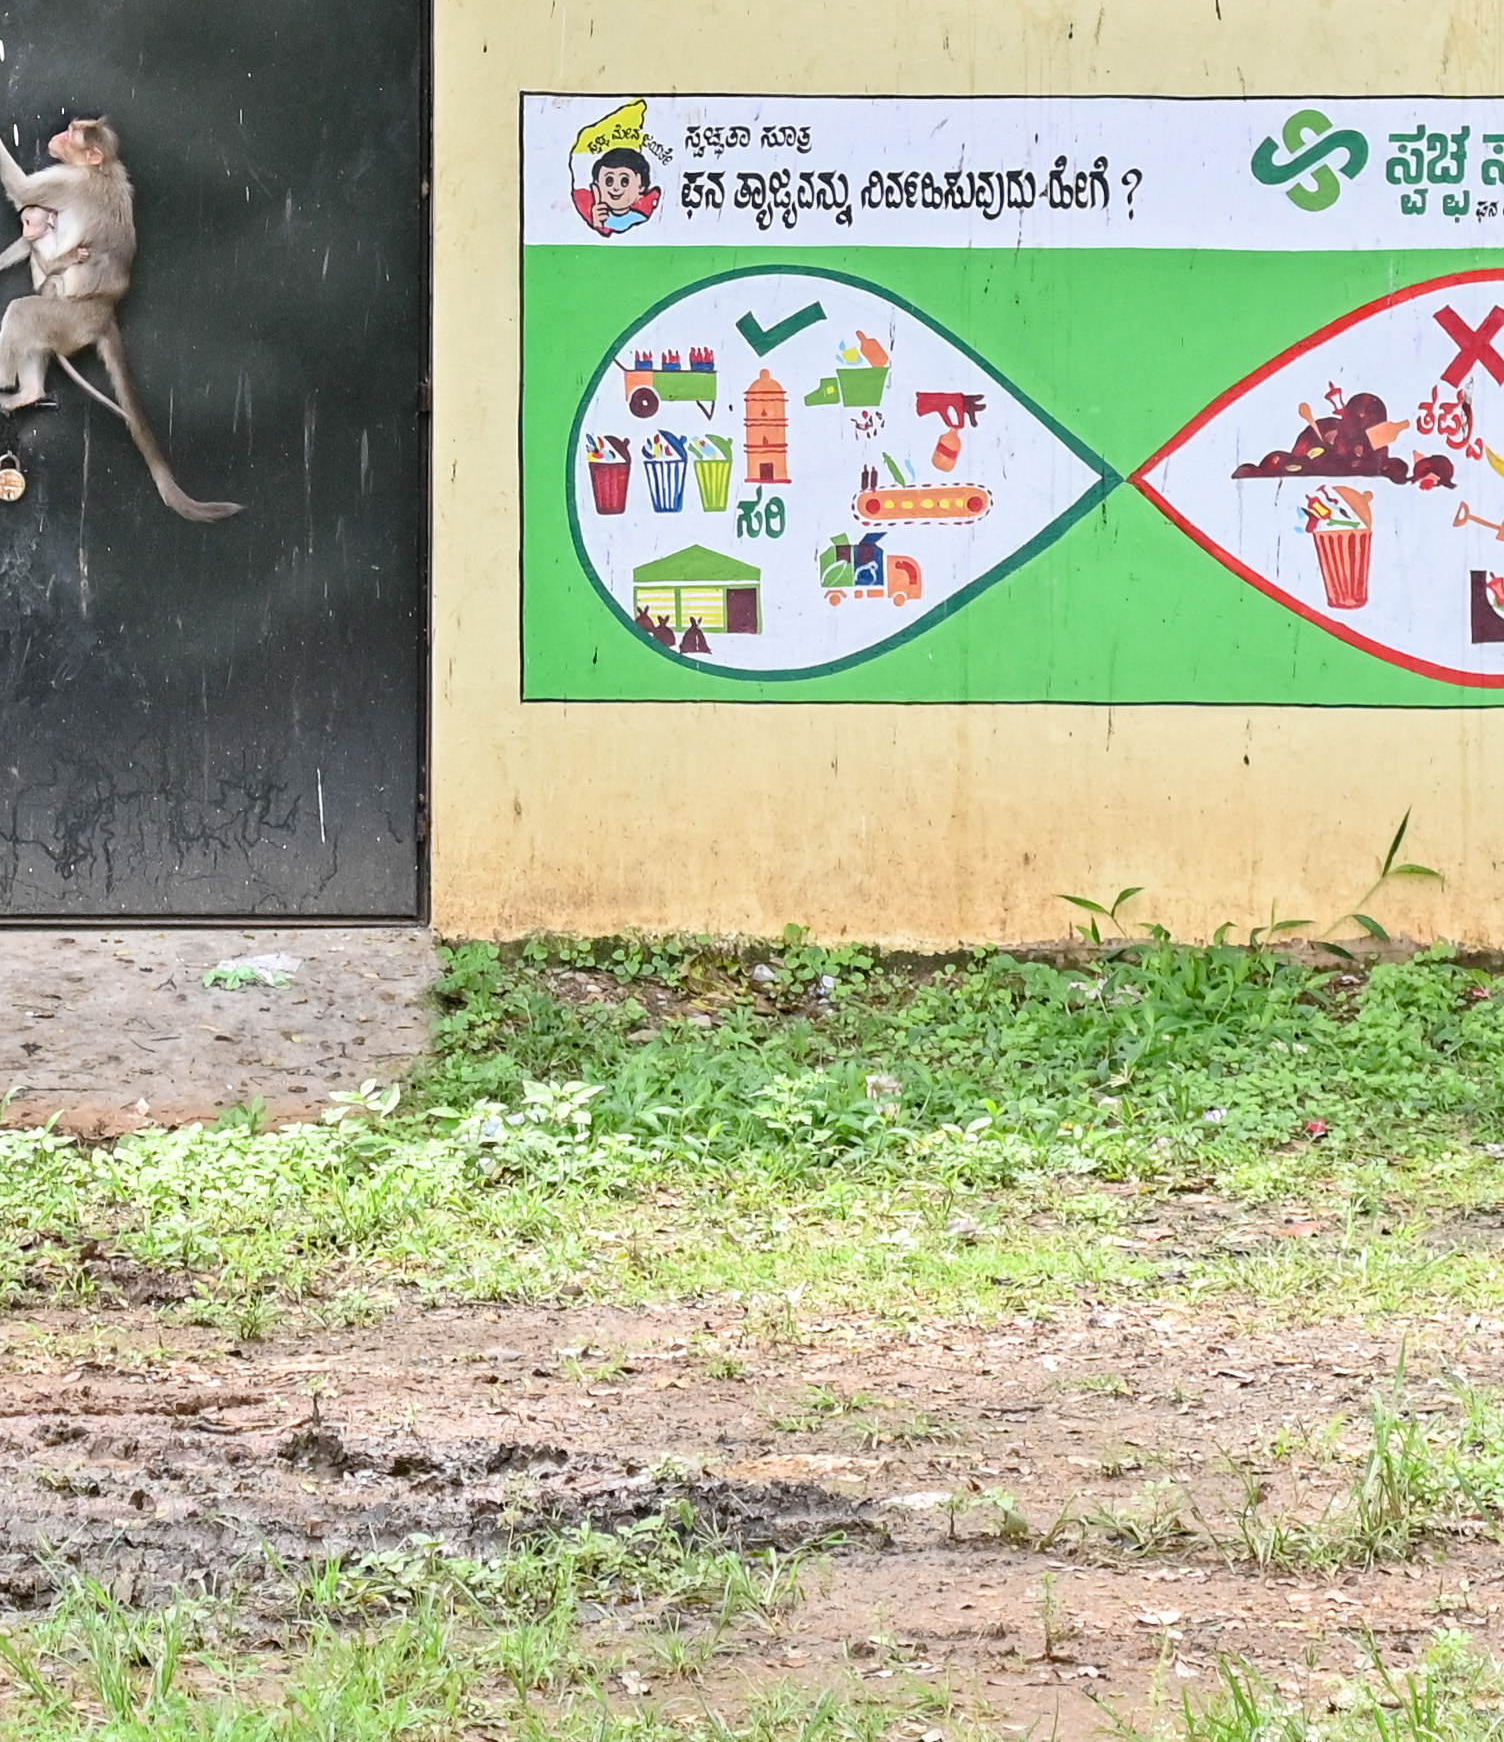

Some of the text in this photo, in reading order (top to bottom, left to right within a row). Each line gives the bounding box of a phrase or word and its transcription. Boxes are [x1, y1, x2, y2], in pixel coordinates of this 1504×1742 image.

[760, 125, 812, 154] ಸೂತ್ರ
[1048, 155, 1110, 210] ಹೇಗೆ
[1416, 384, 1484, 461] ತಪ್ಪು
[736, 484, 786, 539] ಸರಿ
